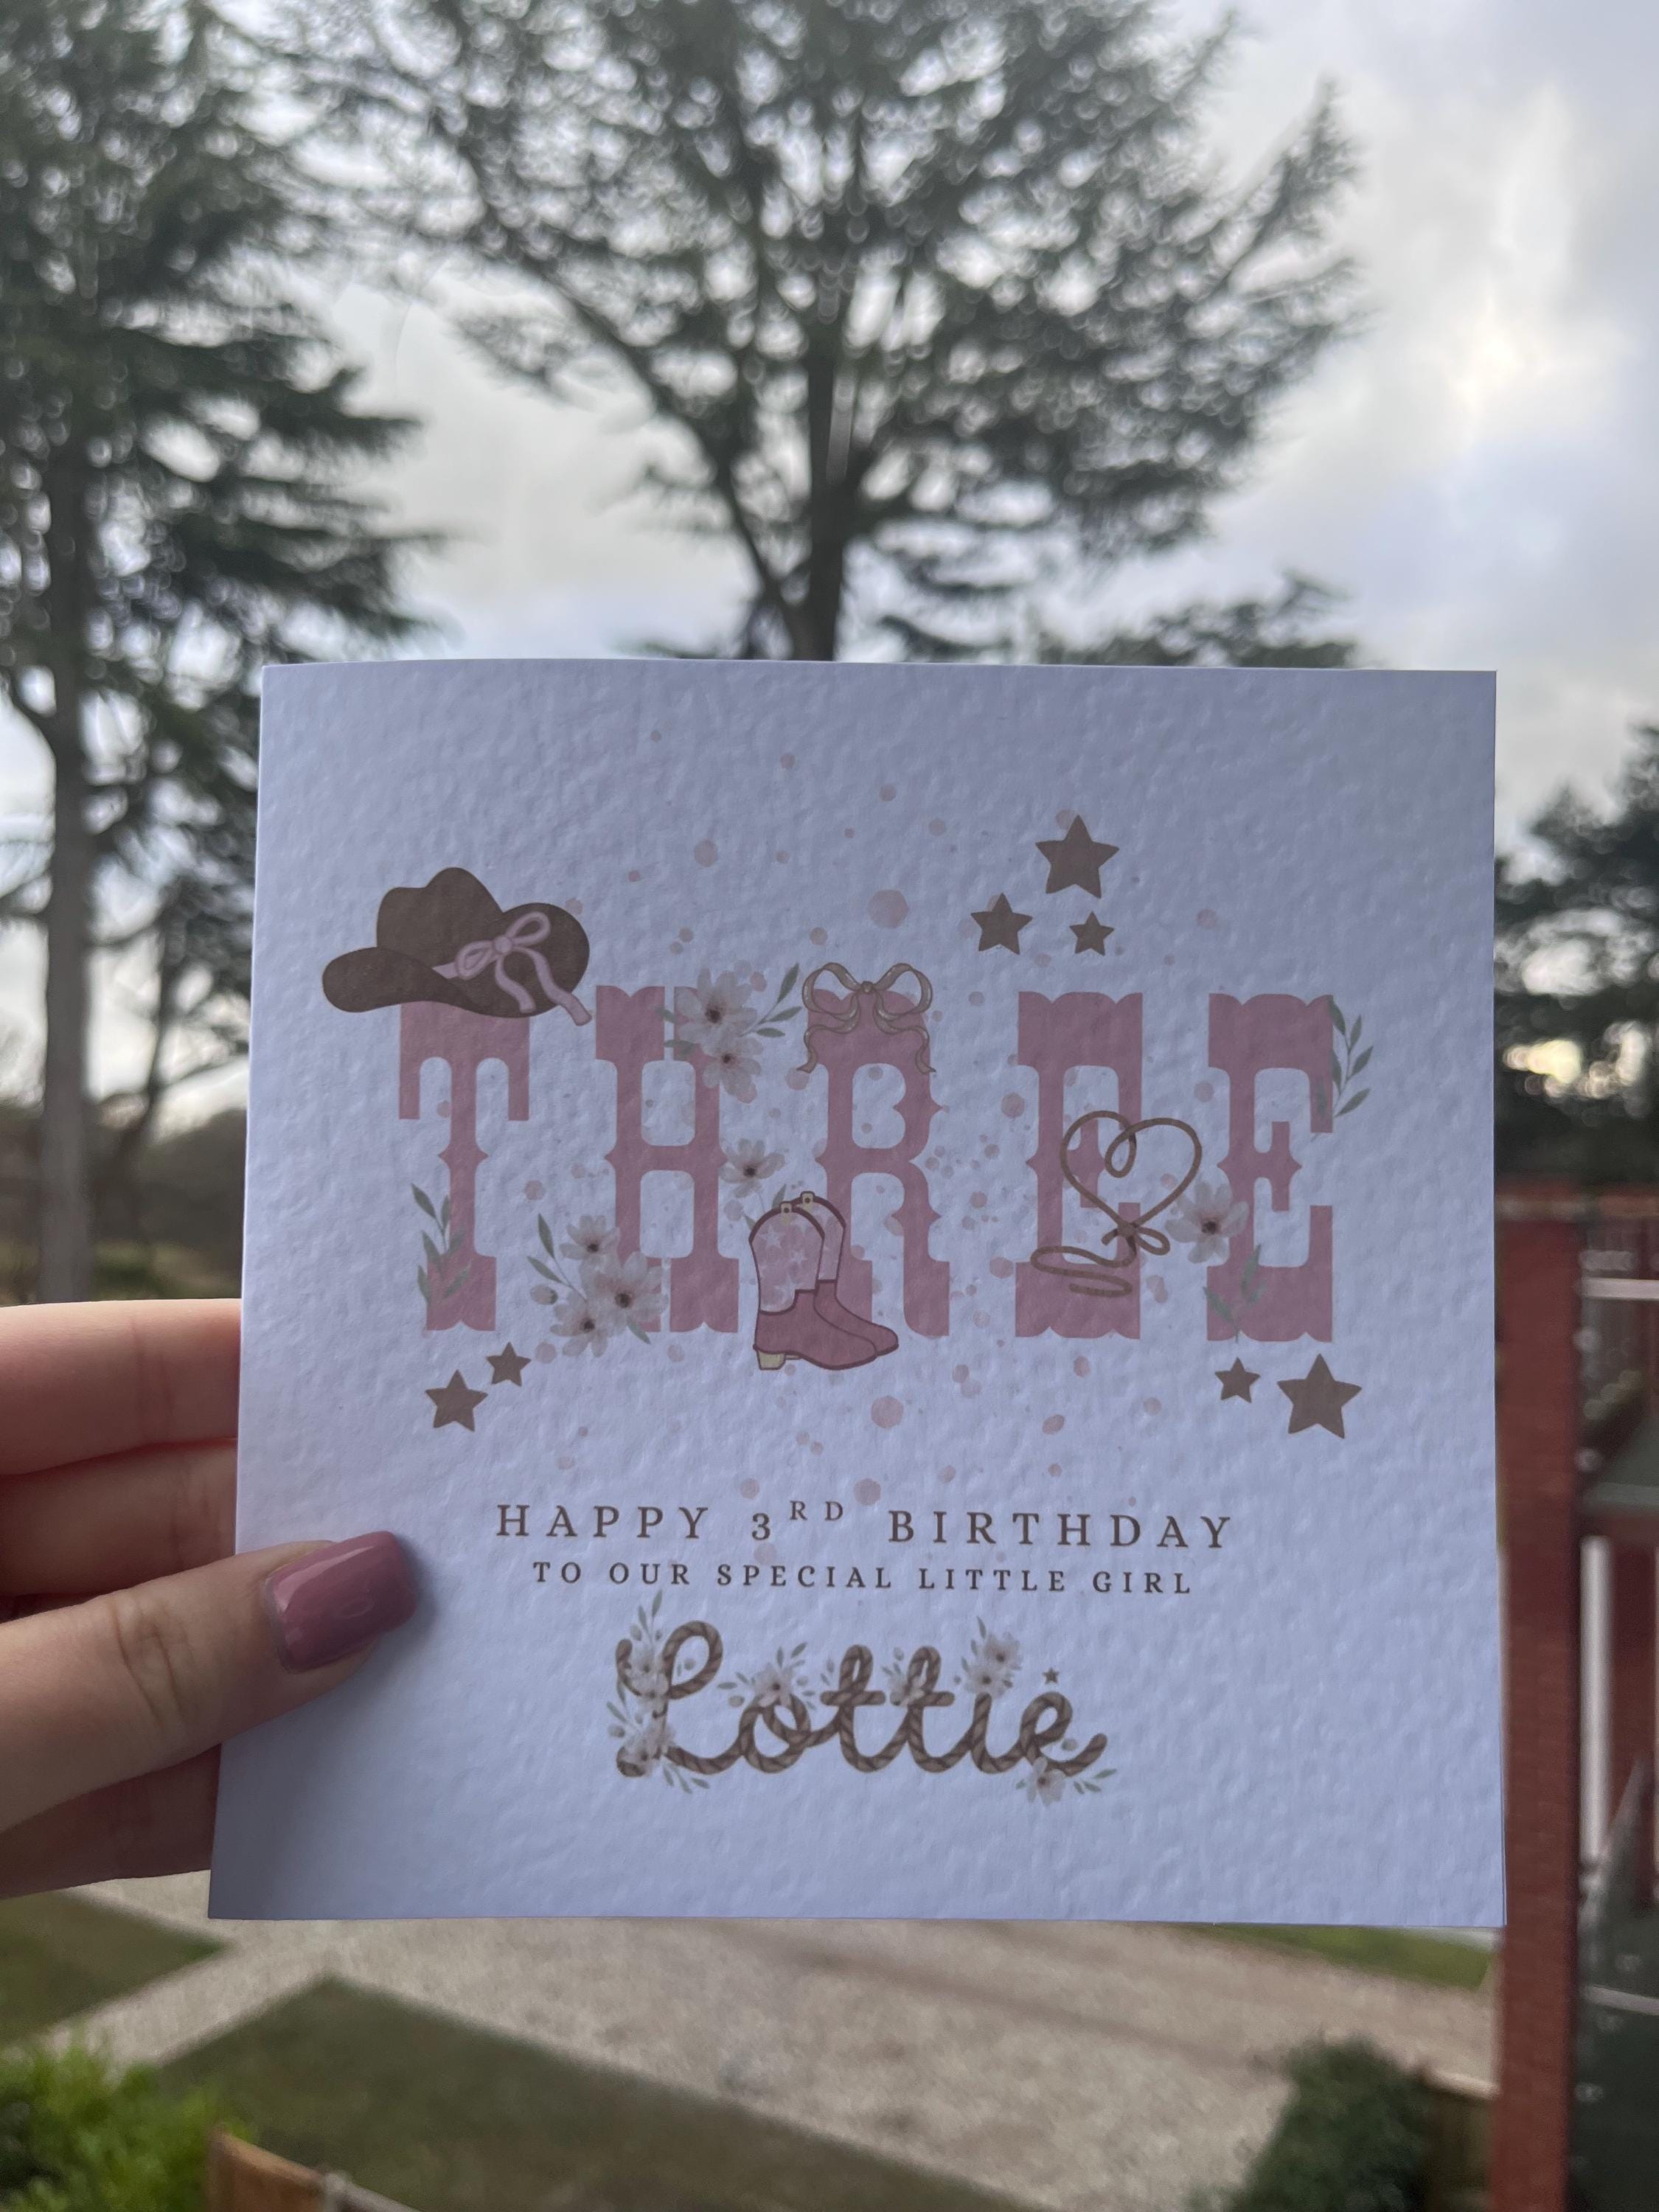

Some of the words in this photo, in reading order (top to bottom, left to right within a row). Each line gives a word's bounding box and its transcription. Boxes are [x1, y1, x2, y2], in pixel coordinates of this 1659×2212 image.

[399, 985, 1334, 1342] THREE
[496, 1504, 709, 1539] HAPPY
[751, 1500, 845, 1541] 3RD
[888, 1509, 1231, 1549] BIRTHDAY
[532, 1561, 582, 1584] TO
[609, 1562, 690, 1585] OUR
[717, 1564, 891, 1589] SPECIAL
[918, 1568, 1065, 1591] LITTLE
[1092, 1571, 1191, 1594] GIRL
[615, 1620, 1107, 1778] Lottie
